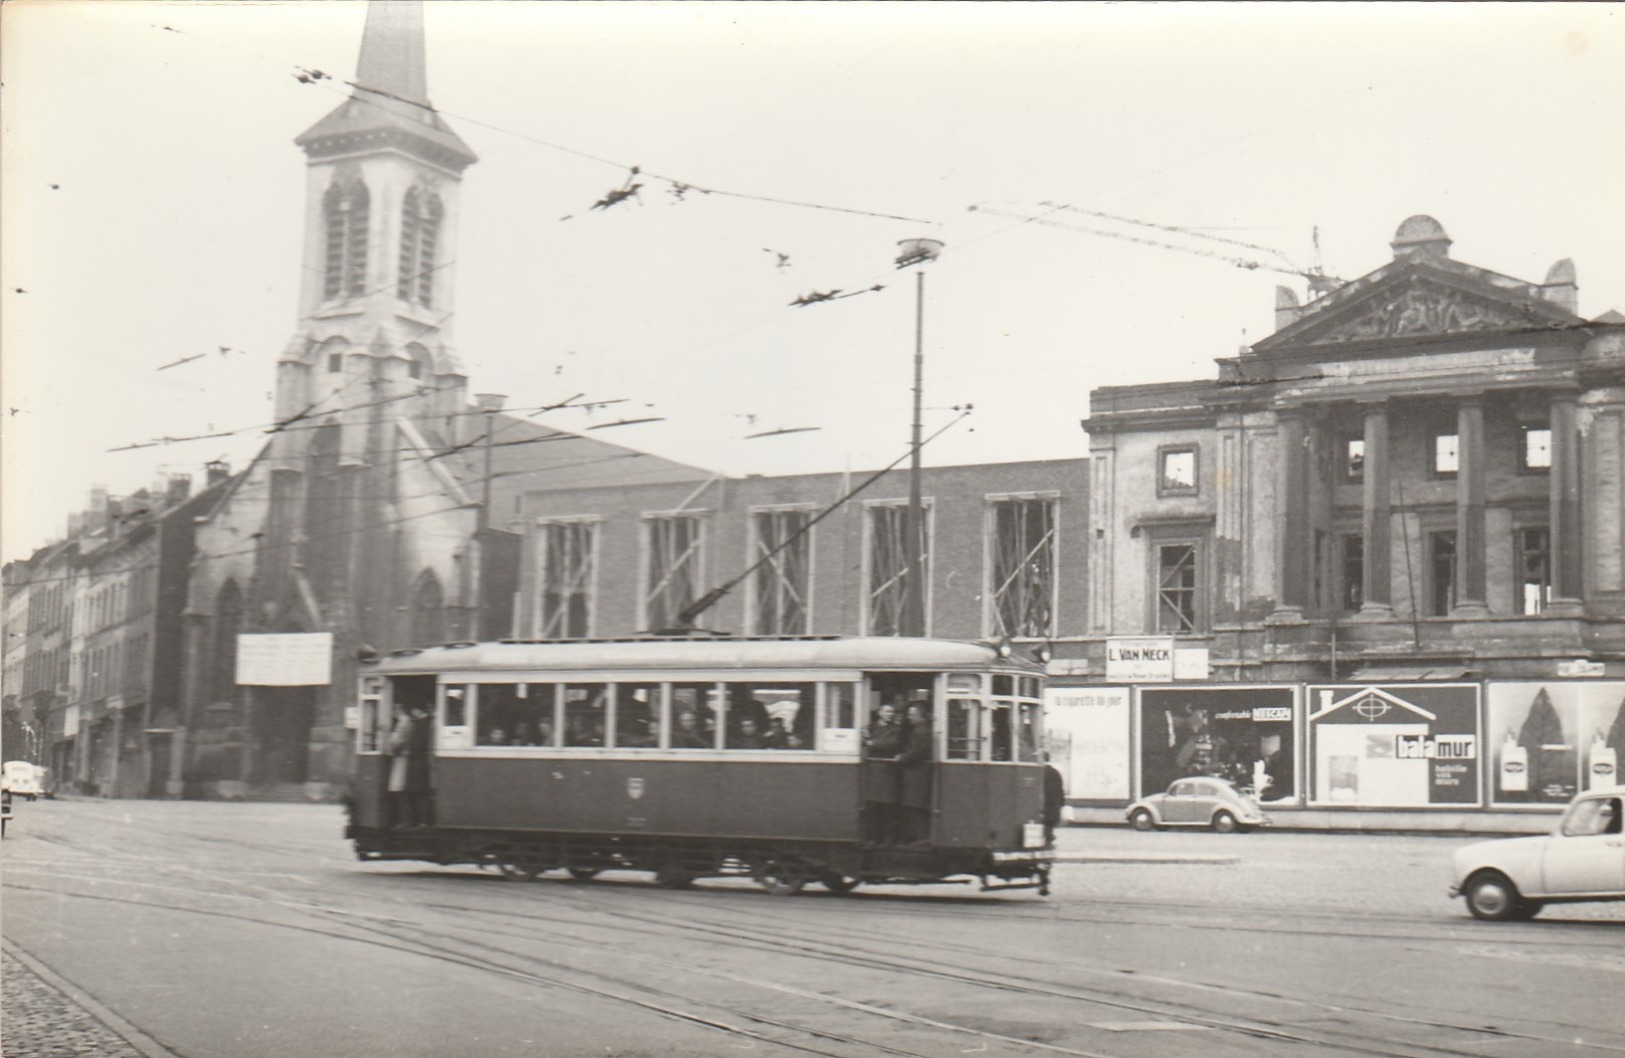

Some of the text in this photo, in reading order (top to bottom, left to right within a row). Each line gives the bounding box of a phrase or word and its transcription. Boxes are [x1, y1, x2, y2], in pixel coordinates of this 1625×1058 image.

[1119, 648, 1139, 661] VAN
[1142, 648, 1170, 661] NECK
[1062, 696, 1095, 708] cigarette
